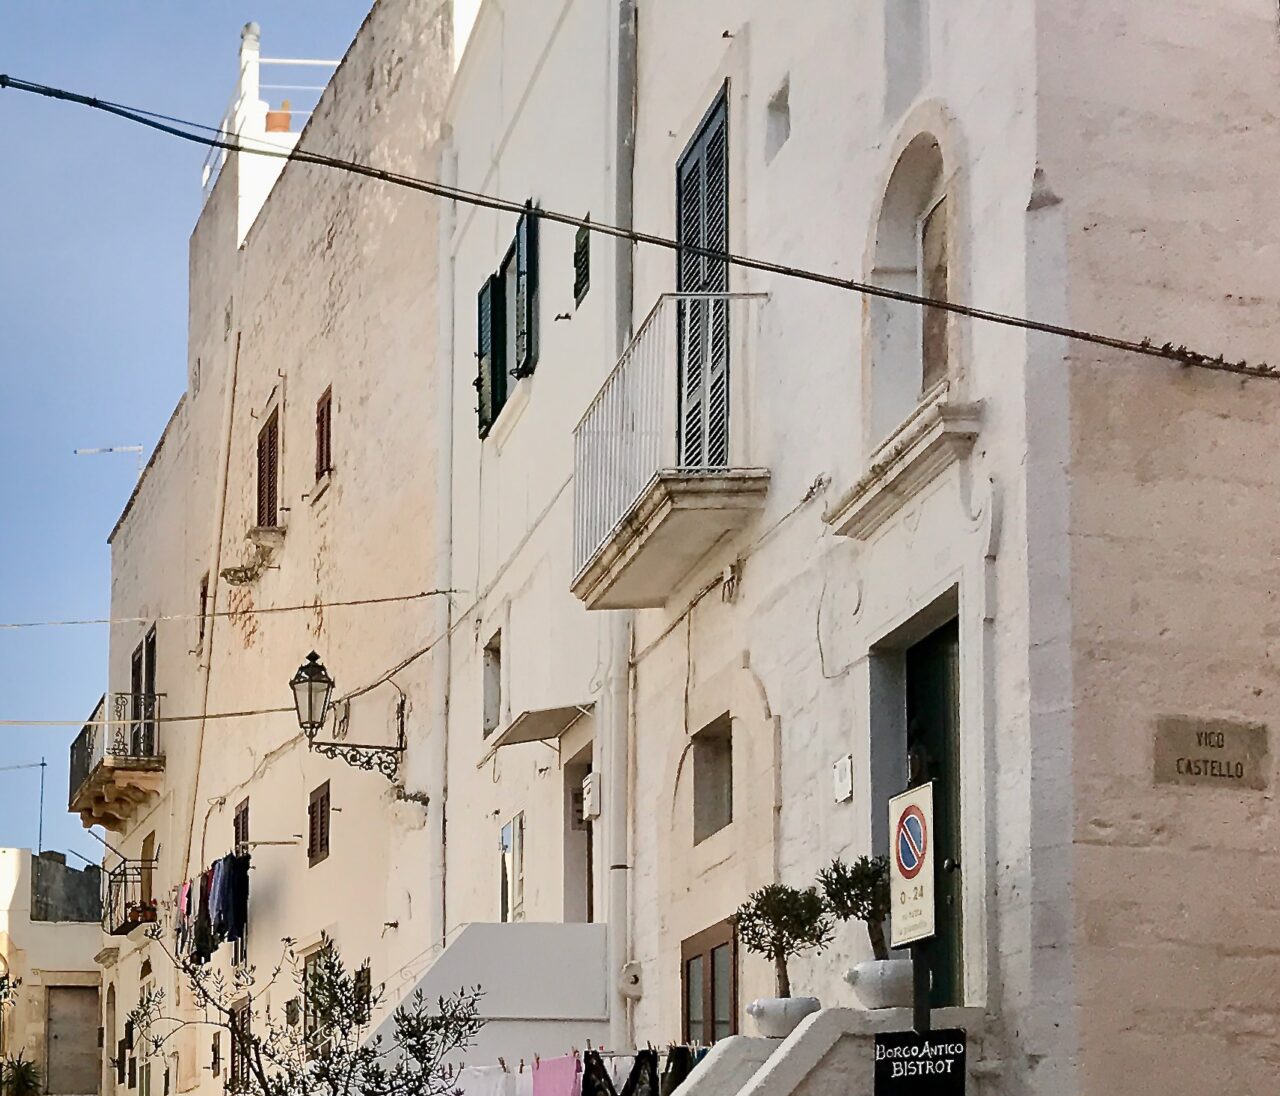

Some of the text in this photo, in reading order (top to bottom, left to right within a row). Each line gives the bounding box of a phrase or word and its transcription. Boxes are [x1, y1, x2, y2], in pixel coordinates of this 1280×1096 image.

[1196, 731, 1225, 749] VICO
[1176, 758, 1244, 779] CASTELLO
[876, 1040, 964, 1061] BORGO ANTICO
[891, 1059, 955, 1078] BISTROT
